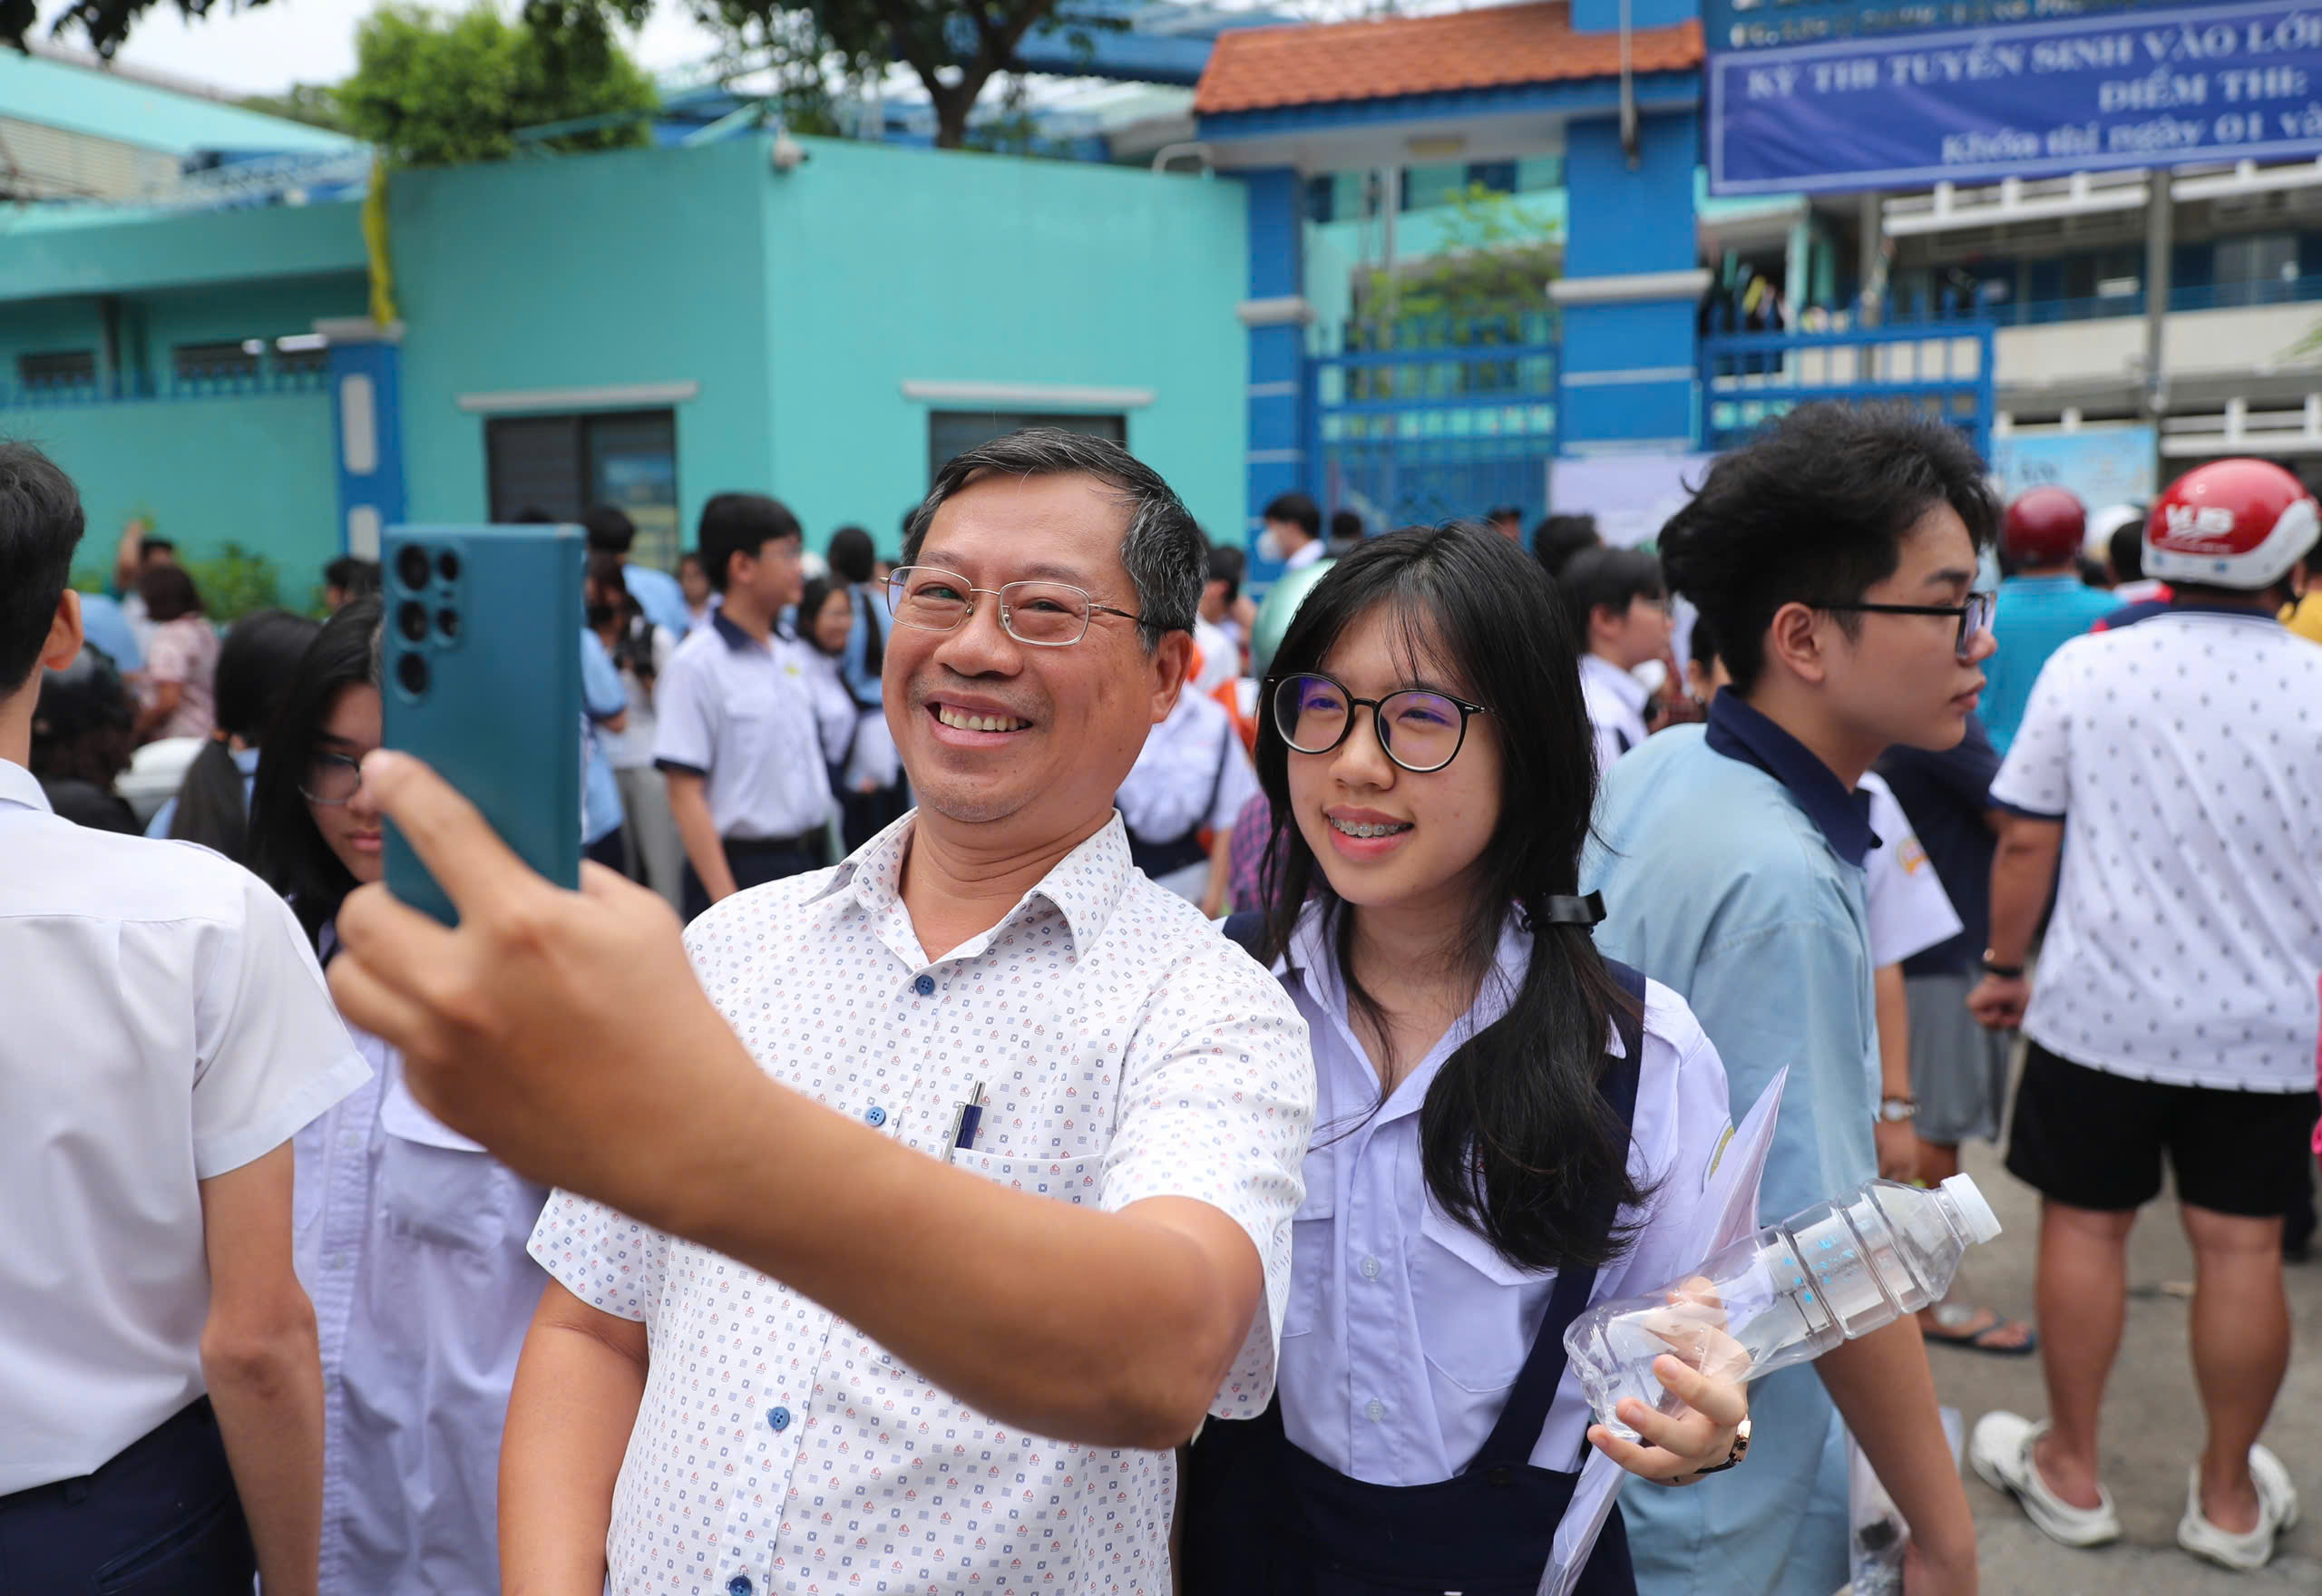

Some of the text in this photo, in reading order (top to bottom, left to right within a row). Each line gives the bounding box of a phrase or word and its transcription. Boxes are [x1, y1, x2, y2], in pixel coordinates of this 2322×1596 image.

[1808, 57, 1878, 93] THI
[2031, 34, 2133, 73] SINH
[2142, 22, 2238, 61] VÀO
[2213, 111, 2264, 142] 01
